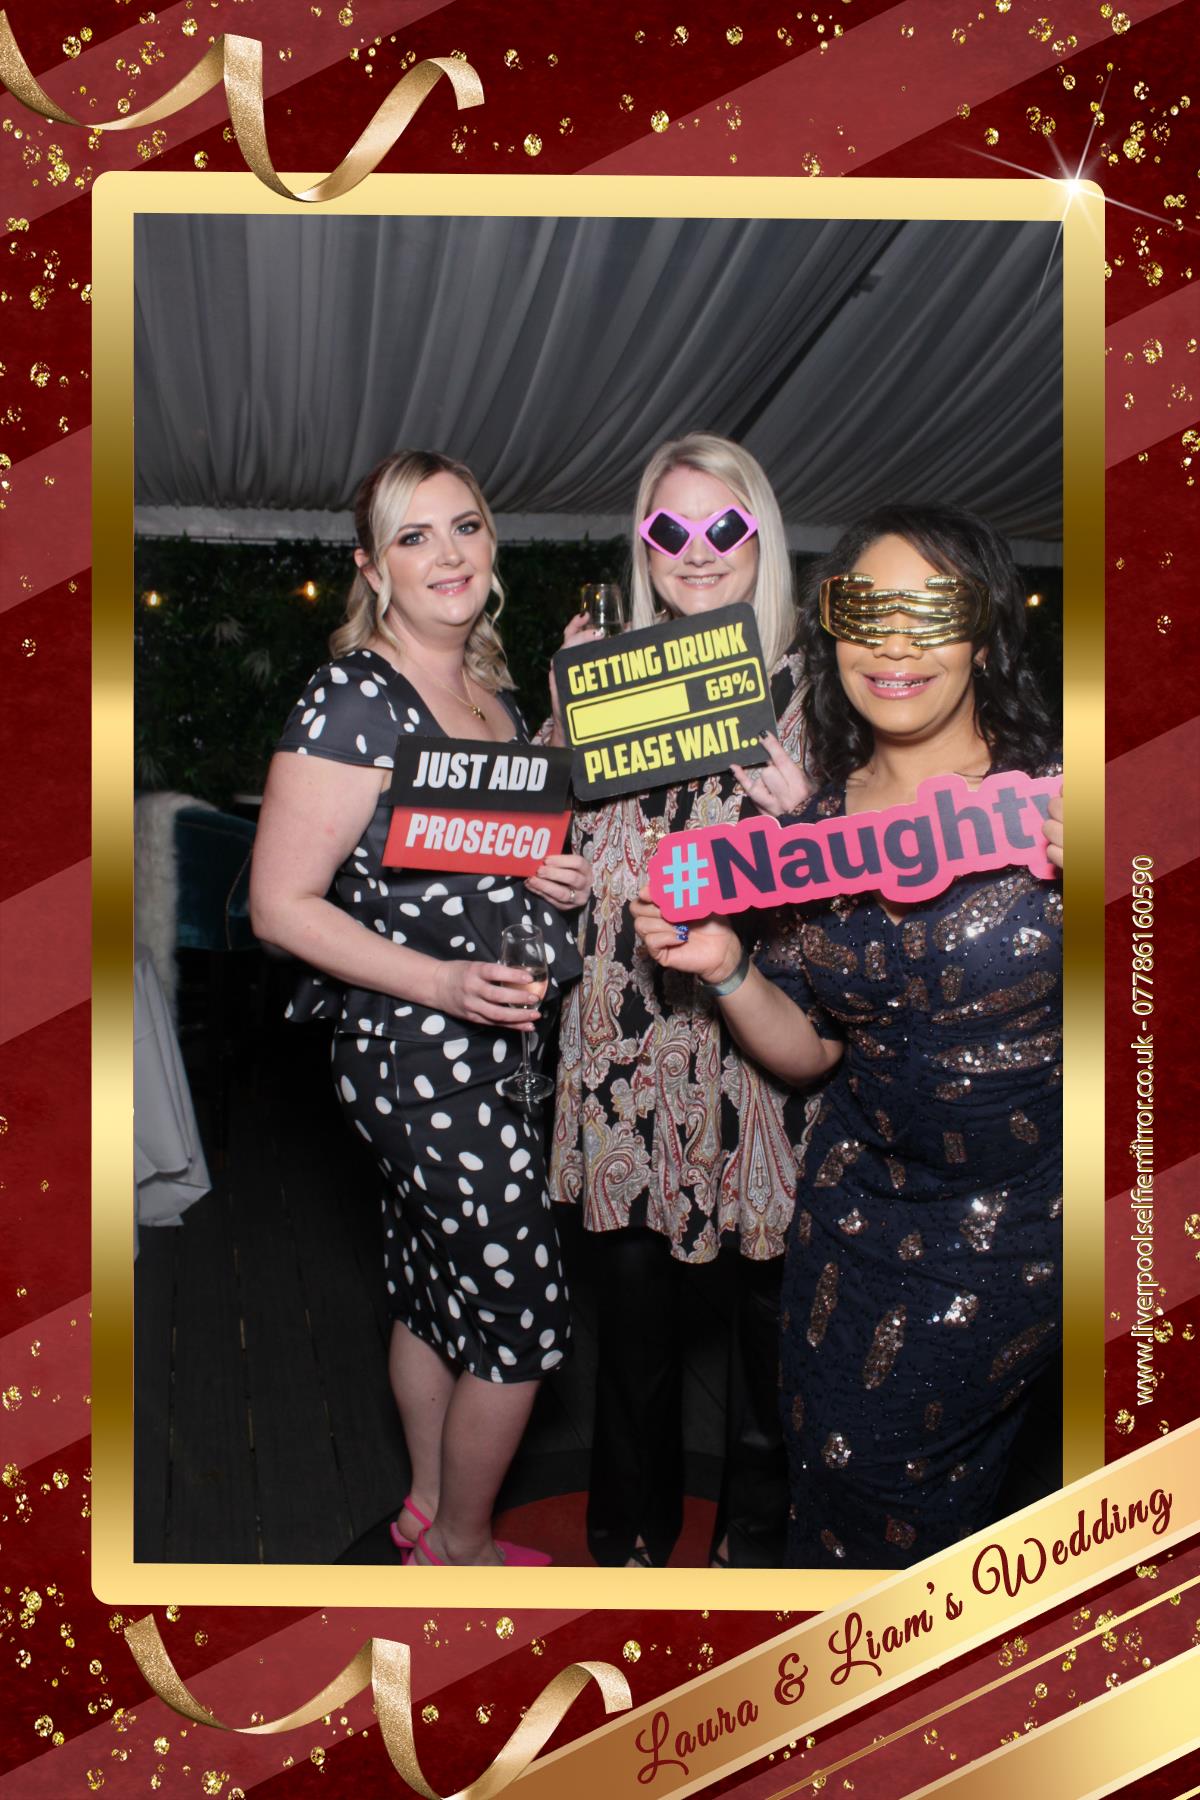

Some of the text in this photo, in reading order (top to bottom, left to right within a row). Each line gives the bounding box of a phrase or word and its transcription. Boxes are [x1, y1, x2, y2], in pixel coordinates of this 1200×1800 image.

[568, 622, 748, 695] GETTING DRUNK
[706, 670, 756, 701] 69%
[413, 751, 549, 792] JUST ADD
[584, 734, 676, 784] PLEASE
[405, 814, 551, 861] PROSECCO
